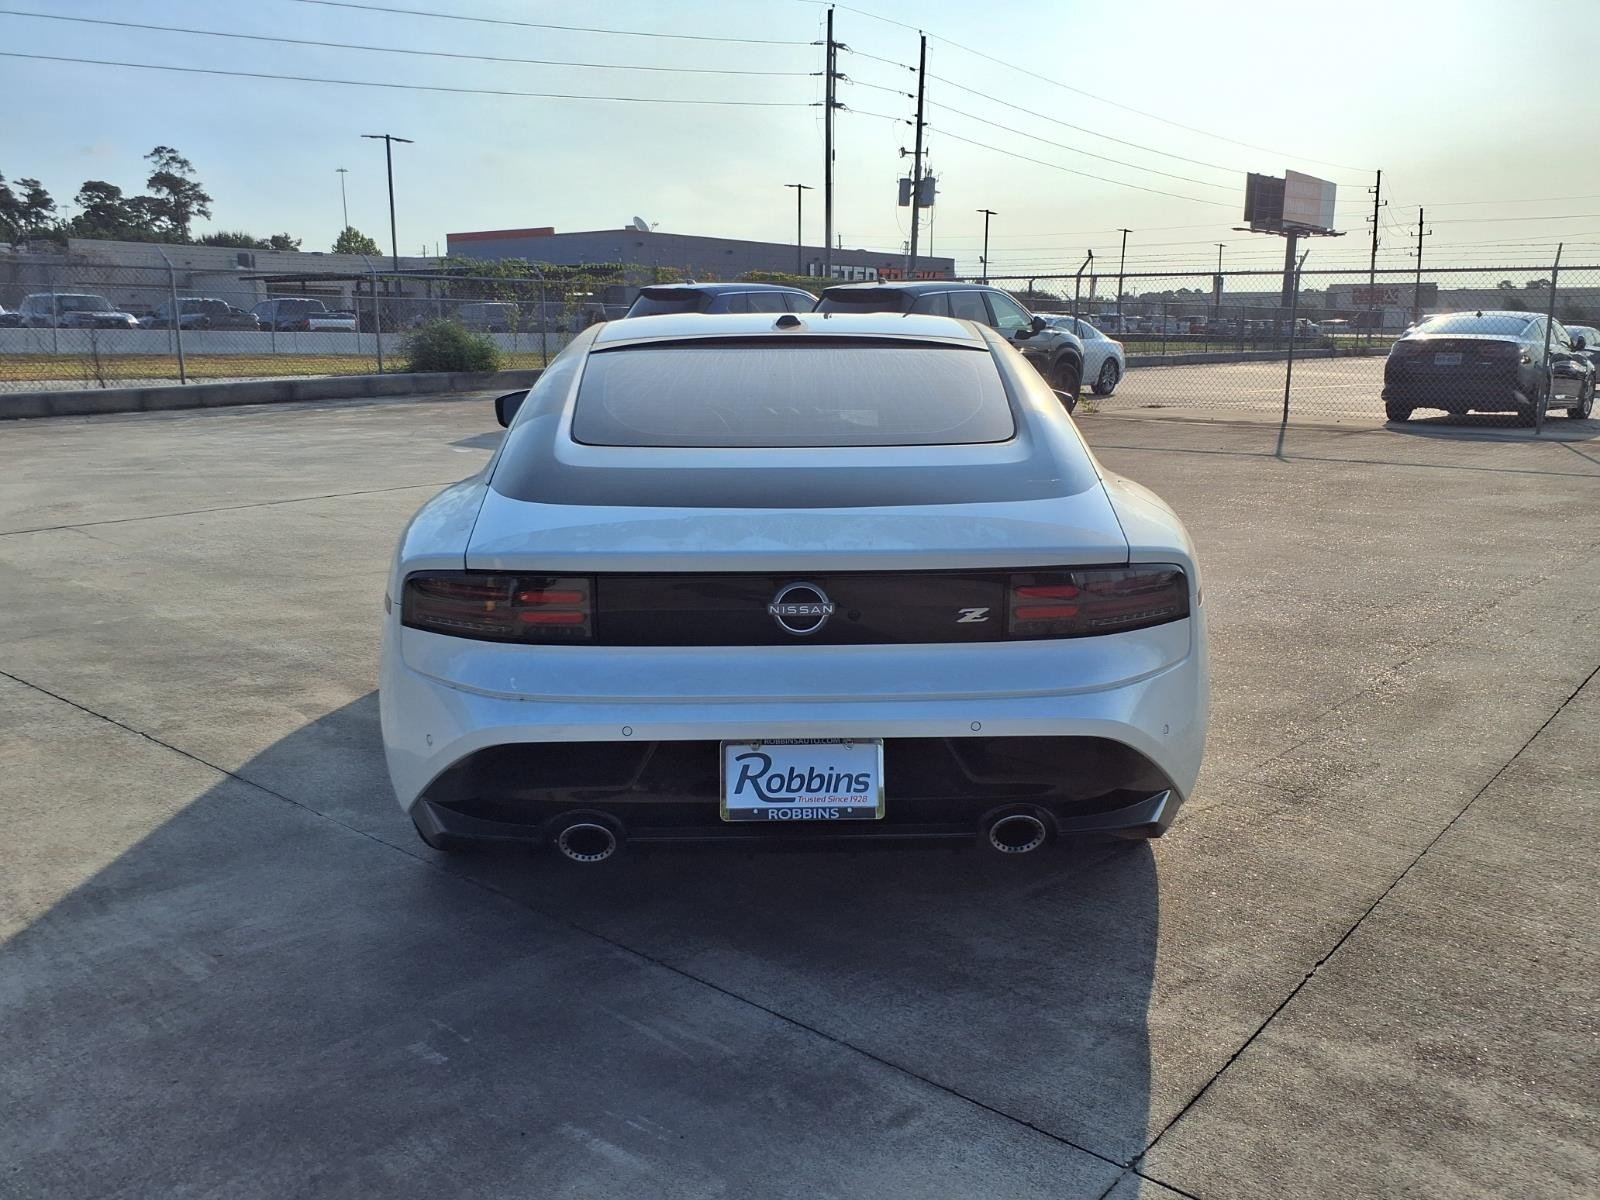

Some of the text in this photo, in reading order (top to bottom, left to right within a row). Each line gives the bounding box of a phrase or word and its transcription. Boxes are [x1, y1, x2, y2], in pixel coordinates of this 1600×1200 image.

[768, 604, 834, 615] NISSAN
[956, 607, 990, 623] Z
[734, 752, 871, 803] Robbins
[798, 795, 868, 803] Trusted Since 1928
[768, 808, 840, 820] ROBBINS
